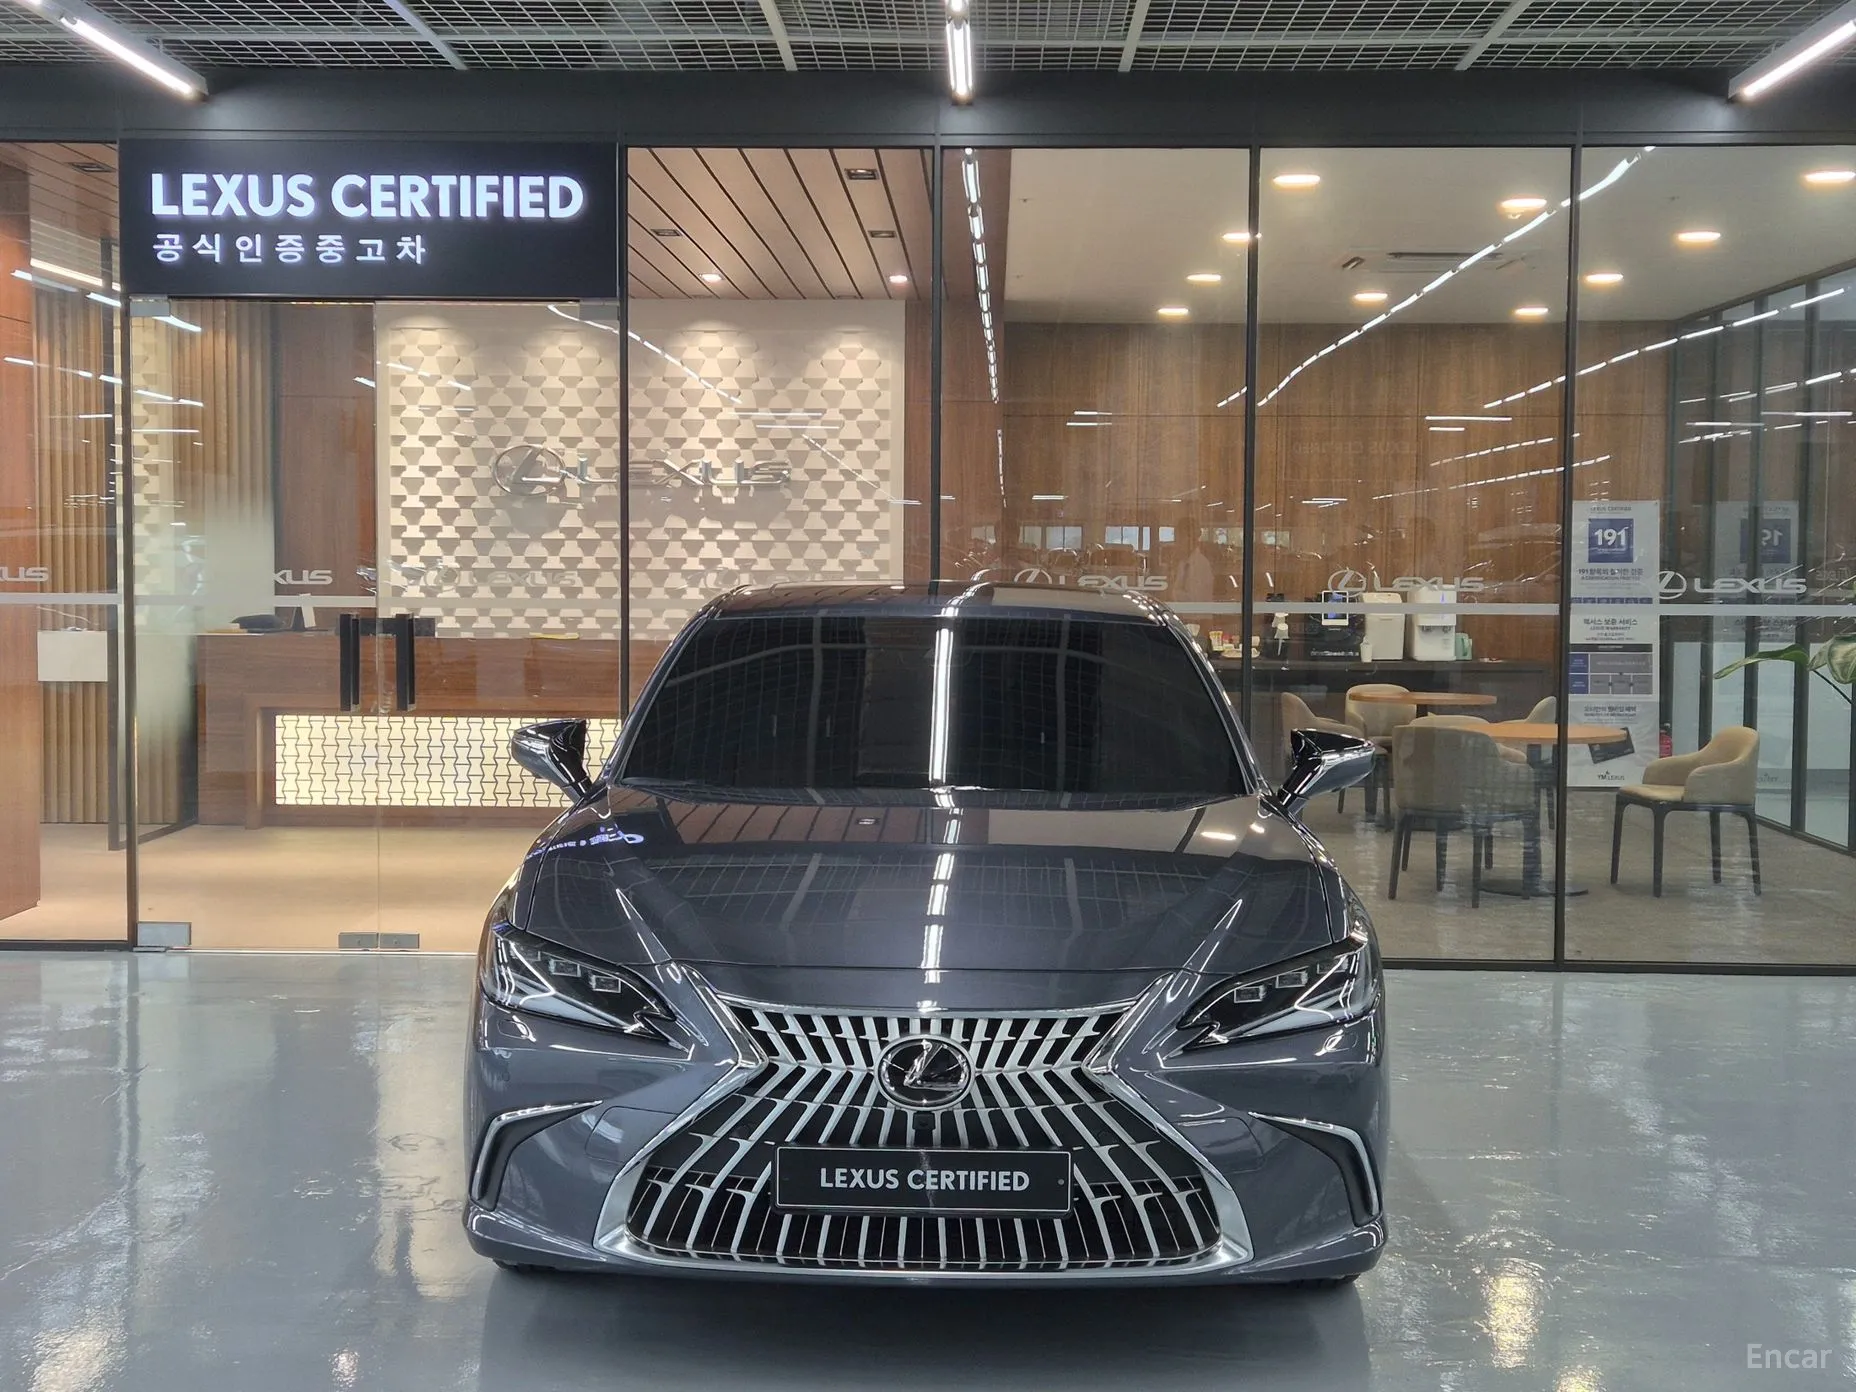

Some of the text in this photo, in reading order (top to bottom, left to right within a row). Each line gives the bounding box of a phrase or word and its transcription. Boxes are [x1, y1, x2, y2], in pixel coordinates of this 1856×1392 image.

[151, 173, 584, 219] LEXUS CERTIFIED
[152, 233, 427, 264] 공식인증중고차
[577, 457, 792, 485] LEXUS
[1594, 528, 1627, 546] 191
[1373, 576, 1485, 592] LEXUS
[1694, 578, 1808, 593] LEXUS
[820, 1167, 1030, 1192] LEXUS CERTIFIED
